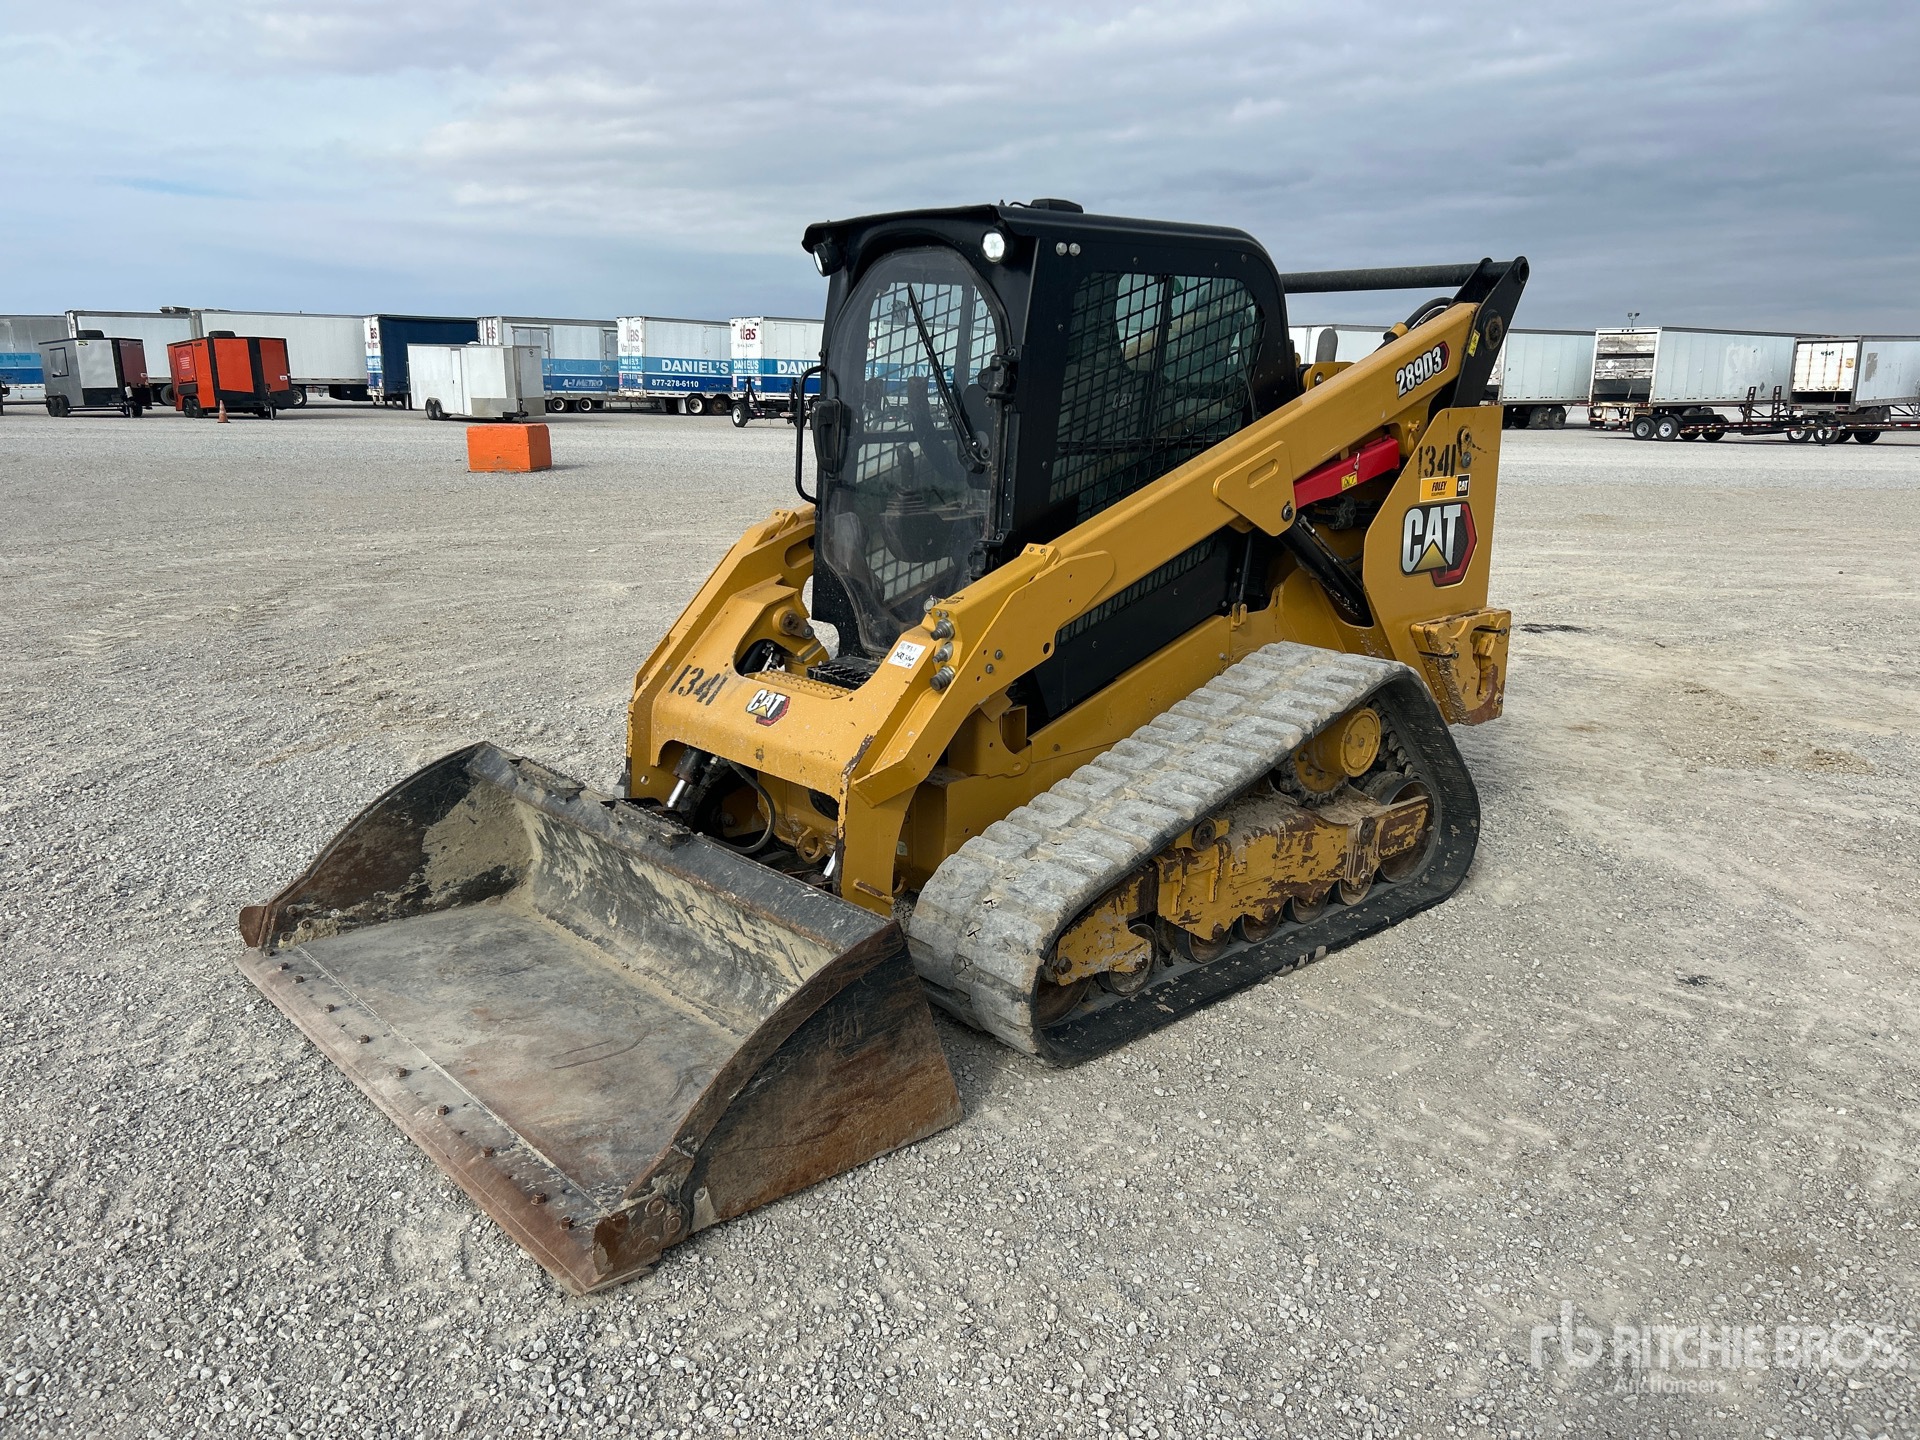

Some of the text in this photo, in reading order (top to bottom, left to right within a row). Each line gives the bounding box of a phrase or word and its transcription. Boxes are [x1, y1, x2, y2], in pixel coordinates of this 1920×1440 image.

[661, 359, 729, 374] DANIEL'S
[1396, 345, 1443, 398] 289D3
[651, 378, 699, 388] 877-278-6110
[1432, 480, 1469, 492] FOLEY CAT
[1401, 504, 1462, 573] CAT
[668, 664, 729, 706] 1341
[747, 689, 787, 718] CAT
